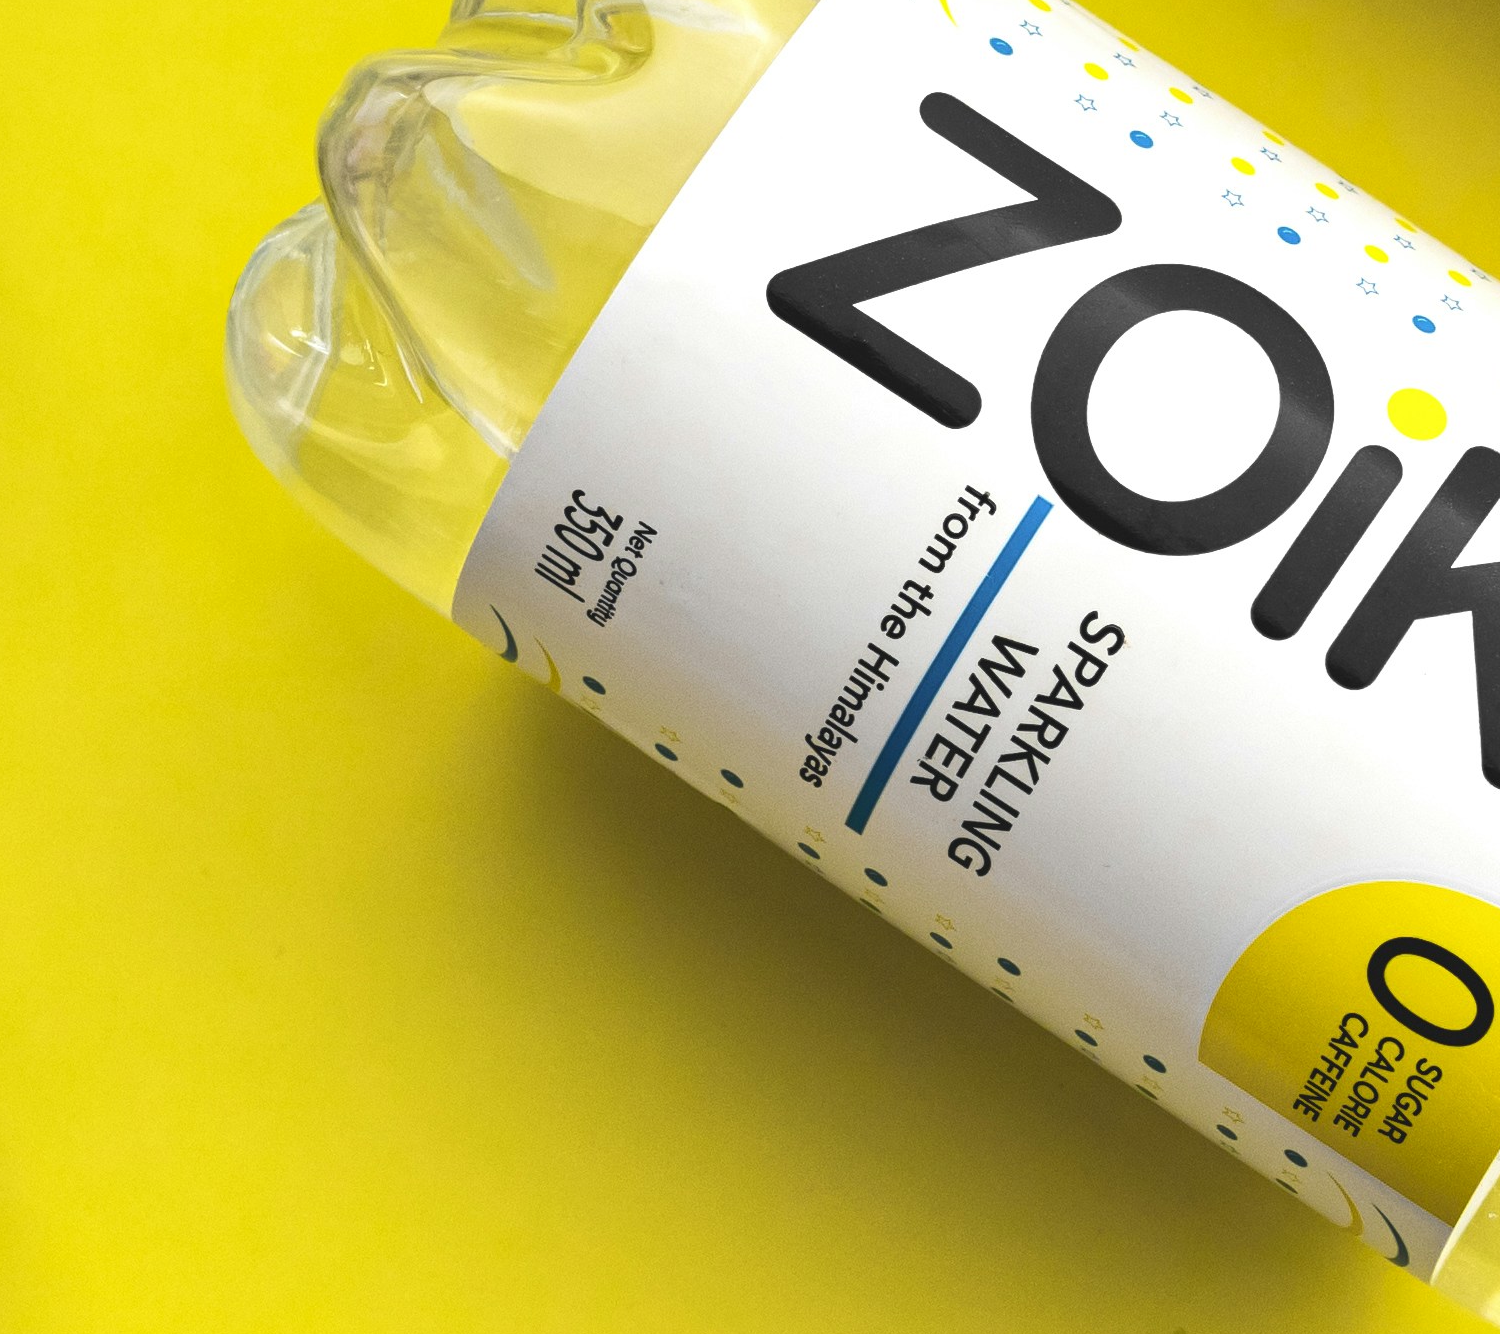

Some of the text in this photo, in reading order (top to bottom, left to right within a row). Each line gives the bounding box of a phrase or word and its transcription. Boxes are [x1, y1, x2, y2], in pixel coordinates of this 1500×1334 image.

[533, 488, 625, 604] 350 ml
[585, 519, 659, 629] Net Quantity
[798, 483, 999, 790] from the Himalayas
[908, 634, 1041, 804] WATER
[946, 609, 1127, 879] SPARKLING
[1365, 935, 1496, 1049] 0
[1290, 1011, 1370, 1124] CAFFEINE
[1331, 1035, 1407, 1139] CALORIE
[1375, 1056, 1444, 1146] SUGAR
